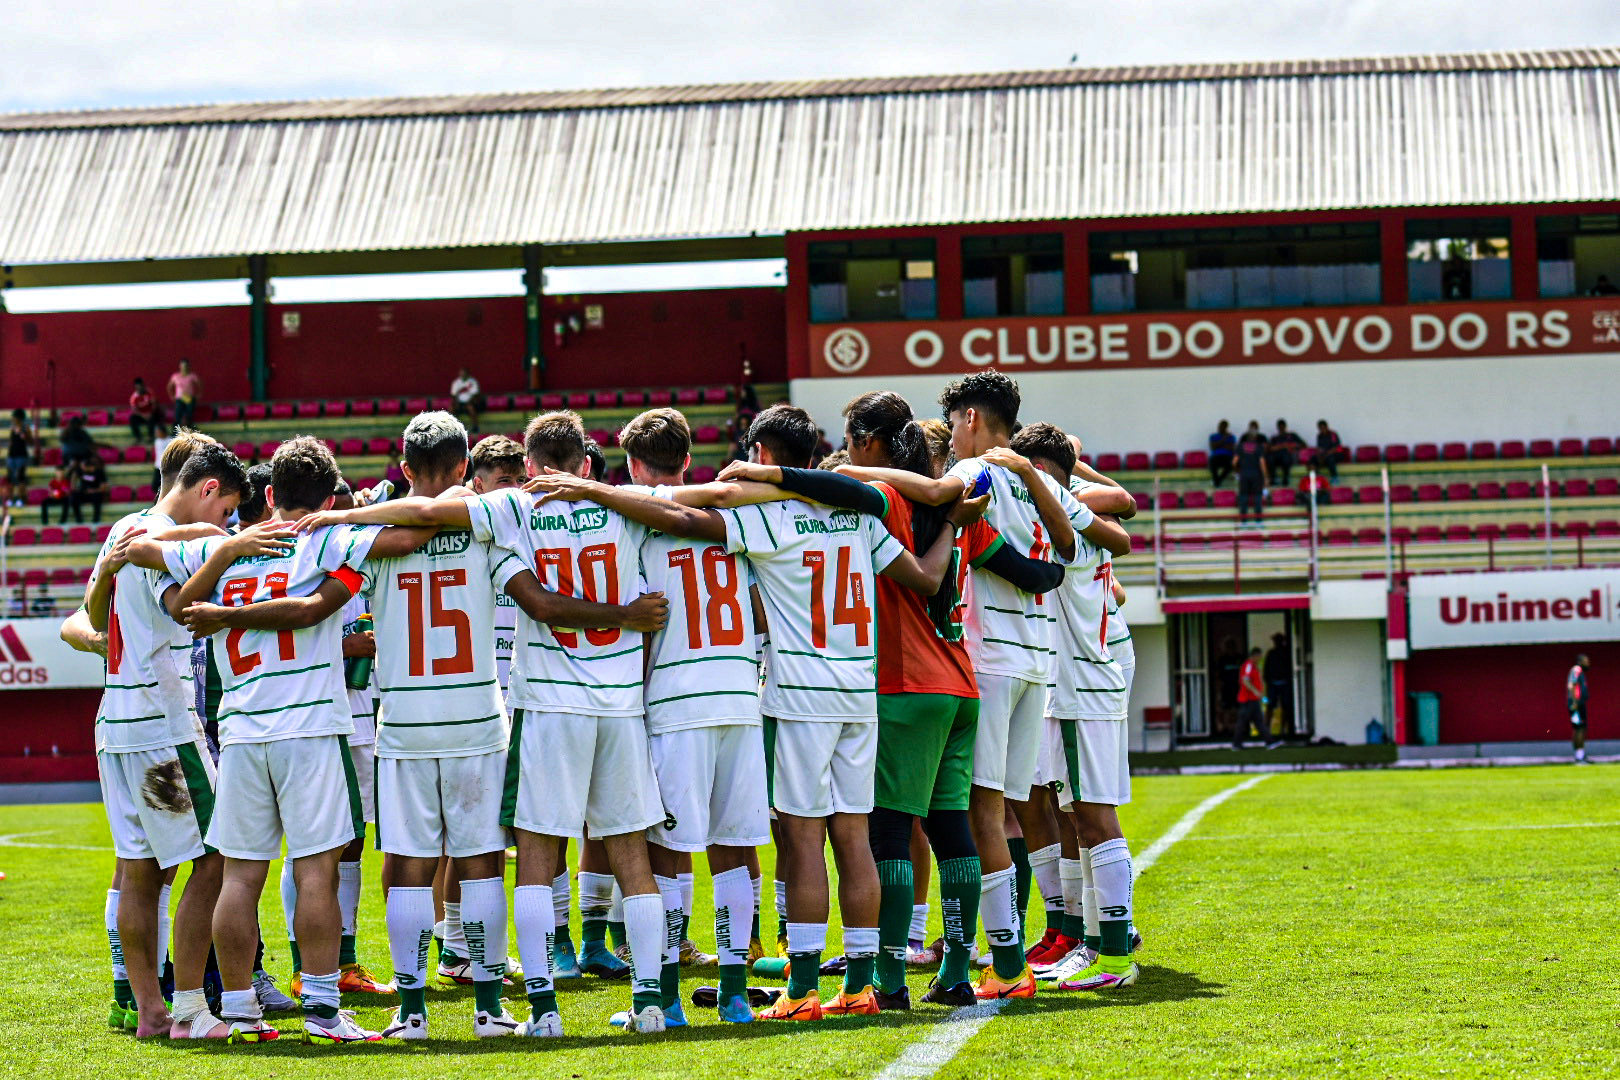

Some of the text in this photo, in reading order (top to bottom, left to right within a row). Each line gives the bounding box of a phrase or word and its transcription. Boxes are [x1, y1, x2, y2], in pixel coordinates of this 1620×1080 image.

[905, 330, 944, 368] O
[960, 324, 1129, 366] CLUBE
[1147, 321, 1224, 360] DO
[1242, 315, 1392, 356] POVO
[1411, 312, 1488, 351] DO
[1507, 309, 1571, 348] RS
[397, 569, 474, 676] 15
[667, 546, 744, 649] 18
[802, 546, 872, 648] 14
[1439, 589, 1602, 625] Unimed
[463, 921, 485, 964] JUVENTUDE
[942, 898, 964, 942] JUVENTUDE
